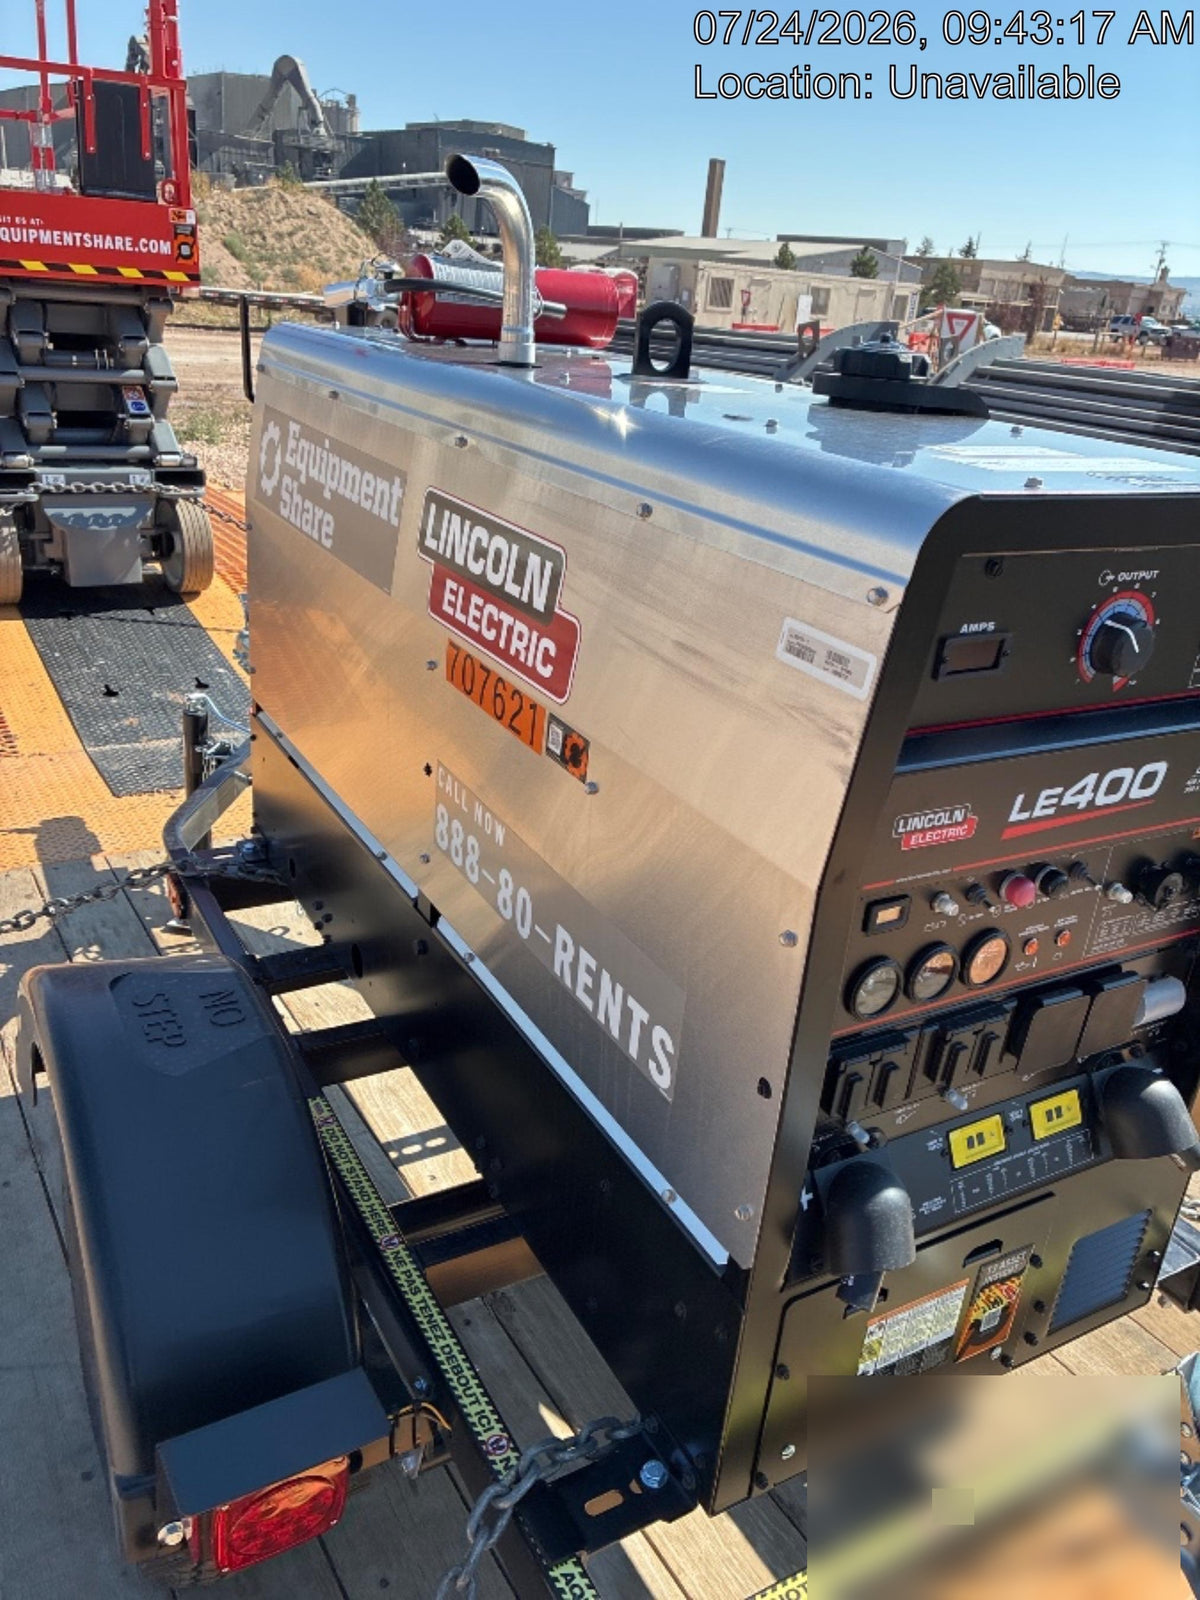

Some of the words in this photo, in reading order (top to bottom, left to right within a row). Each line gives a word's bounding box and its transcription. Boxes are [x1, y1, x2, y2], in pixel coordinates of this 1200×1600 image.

[280, 473, 336, 549] Share
[284, 420, 403, 527] Equipment
[424, 502, 554, 613] LINCOLN
[1117, 570, 1160, 582] OUTPUT
[441, 578, 557, 679] ELECTRIC
[959, 621, 996, 634] AMPS
[448, 641, 538, 747] 707621
[436, 766, 468, 812] CALL
[474, 802, 506, 846] NOW
[897, 808, 966, 833] LINCOLN
[1007, 760, 1169, 823] LE400
[910, 824, 968, 845] ELECTRIC
[435, 803, 675, 1089] 888-80-RENTS
[131, 992, 188, 1048] STEP
[198, 990, 247, 1028] NO
[325, 1127, 341, 1142] DO
[334, 1143, 354, 1165] NOT
[345, 1165, 373, 1203] STAND
[366, 1203, 391, 1236] HERE
[391, 1249, 407, 1268] NE
[402, 1267, 422, 1295] PAS
[415, 1297, 446, 1342] TENEZ
[439, 1344, 482, 1411] DEBOUT
[474, 1409, 495, 1434] ICI
